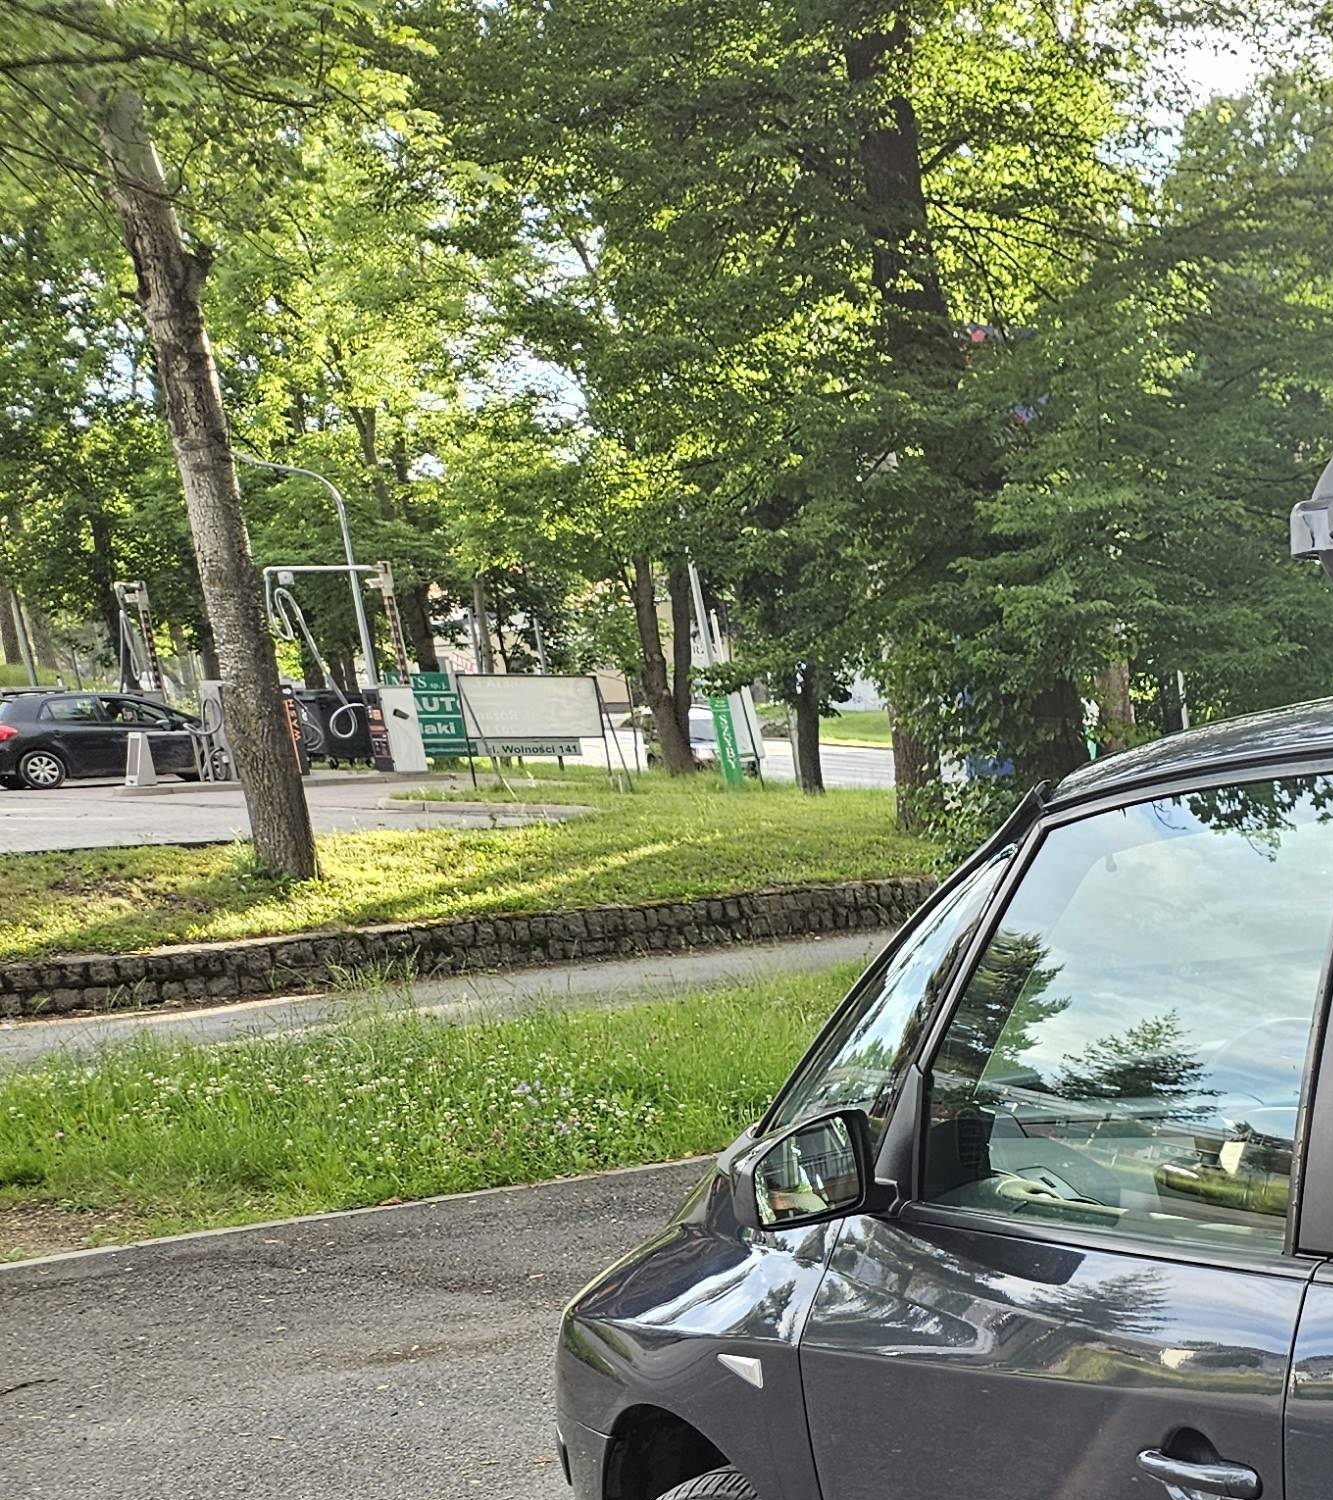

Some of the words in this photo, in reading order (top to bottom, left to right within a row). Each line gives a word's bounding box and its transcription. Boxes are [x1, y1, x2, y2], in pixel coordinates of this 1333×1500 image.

[414, 697, 460, 711] AUT
[287, 699, 302, 741] WASH
[502, 745, 555, 754] Wolności
[560, 745, 578, 754] 141
[719, 714, 737, 769] SZYBY
